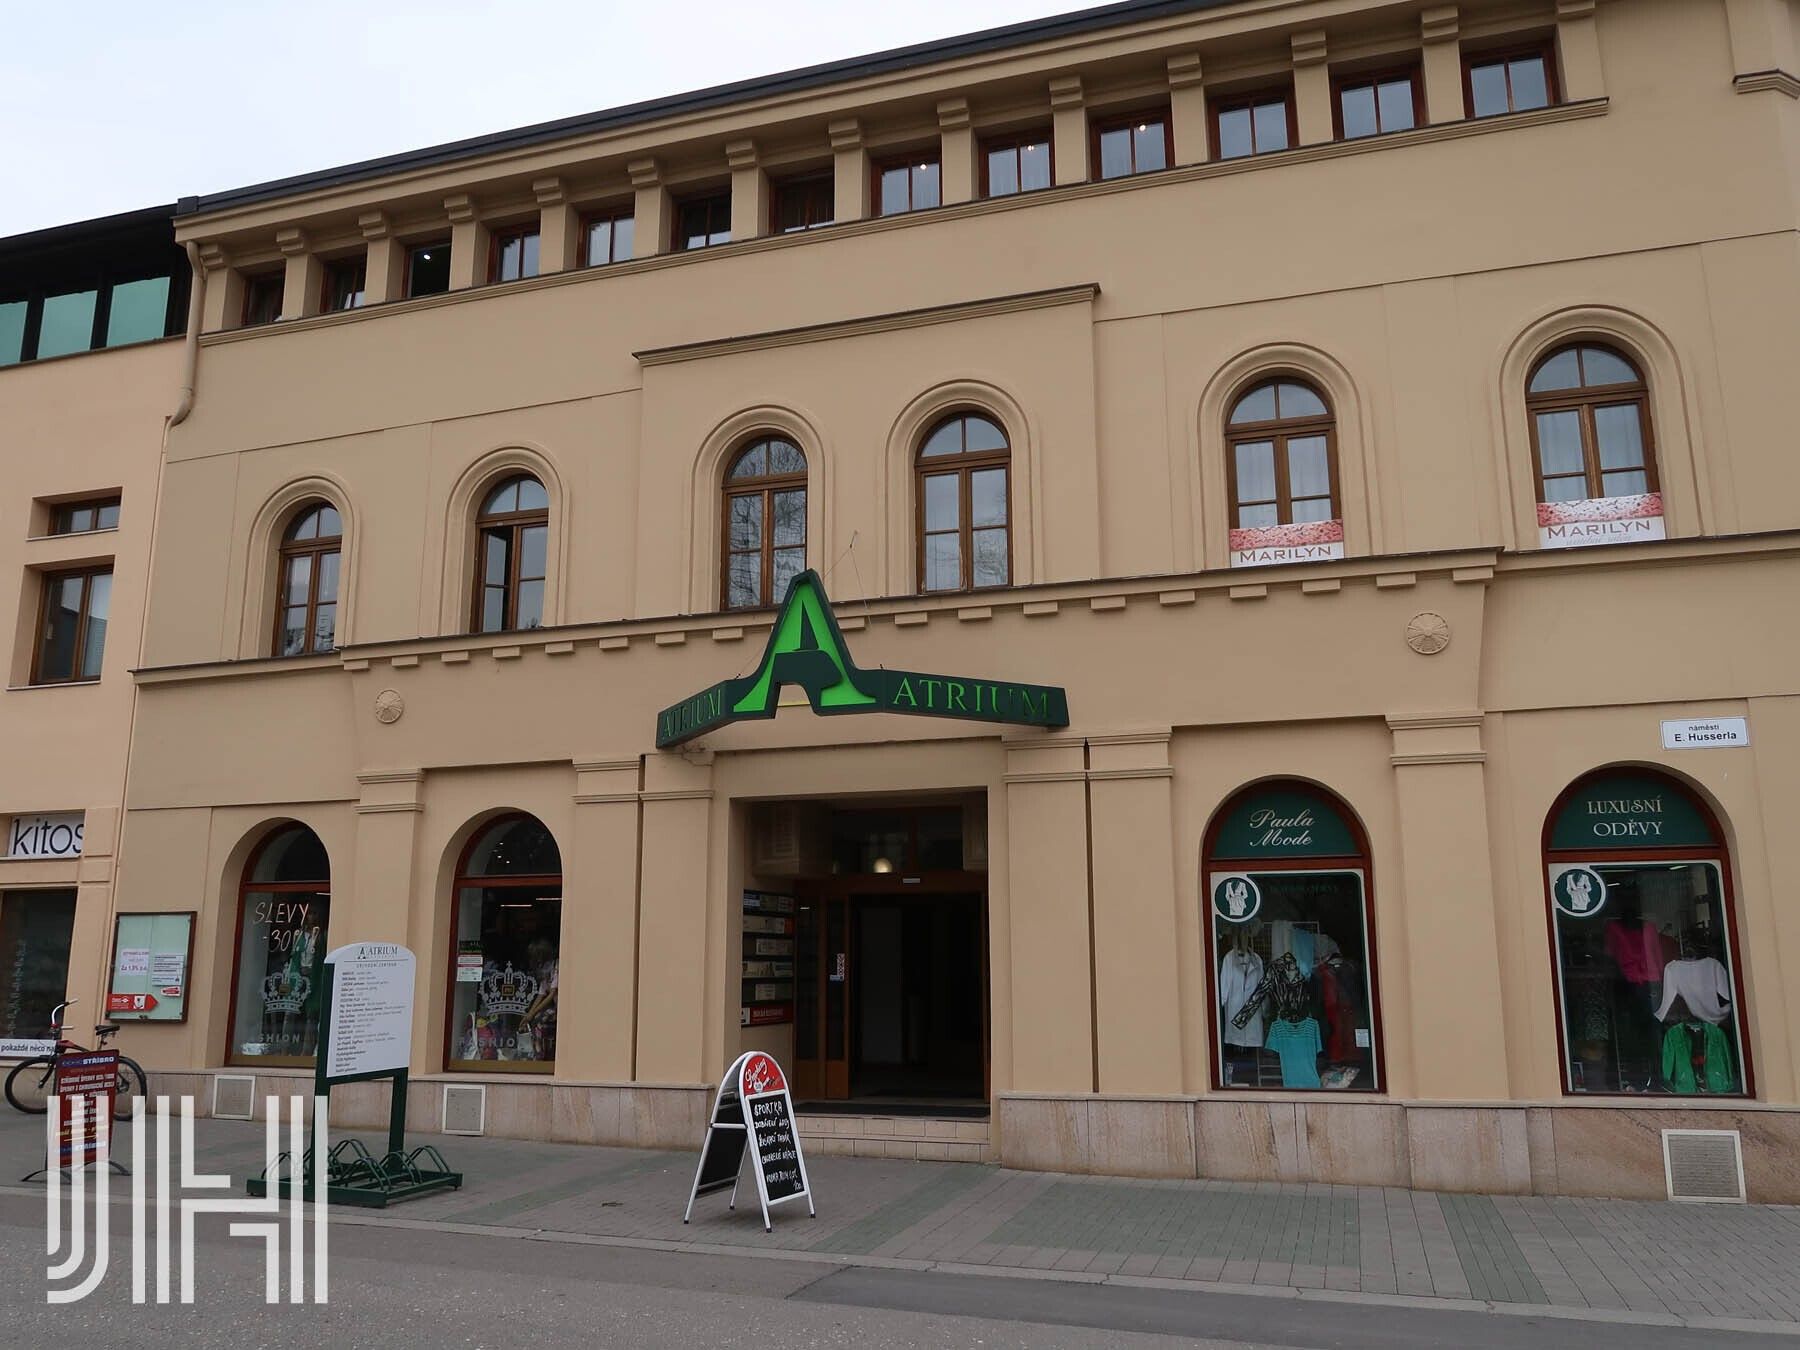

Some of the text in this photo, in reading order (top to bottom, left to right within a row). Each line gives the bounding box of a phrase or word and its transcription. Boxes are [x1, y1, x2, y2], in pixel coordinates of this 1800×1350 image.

[1548, 520, 1651, 539] MARILYN
[1240, 546, 1331, 563] MARILYN
[893, 676, 1050, 719] ATRIUM
[662, 688, 721, 740] ATRIUM
[1674, 731, 1737, 742] E. Husserla
[1688, 723, 1720, 732] náměstí
[1588, 794, 1663, 814] LUXUSNÍ
[1249, 808, 1315, 829] Paula
[1593, 819, 1663, 837] ODĚVY
[1249, 828, 1313, 847] Mode
[253, 901, 309, 926] SLEVY
[368, 946, 398, 955] ATRIUM
